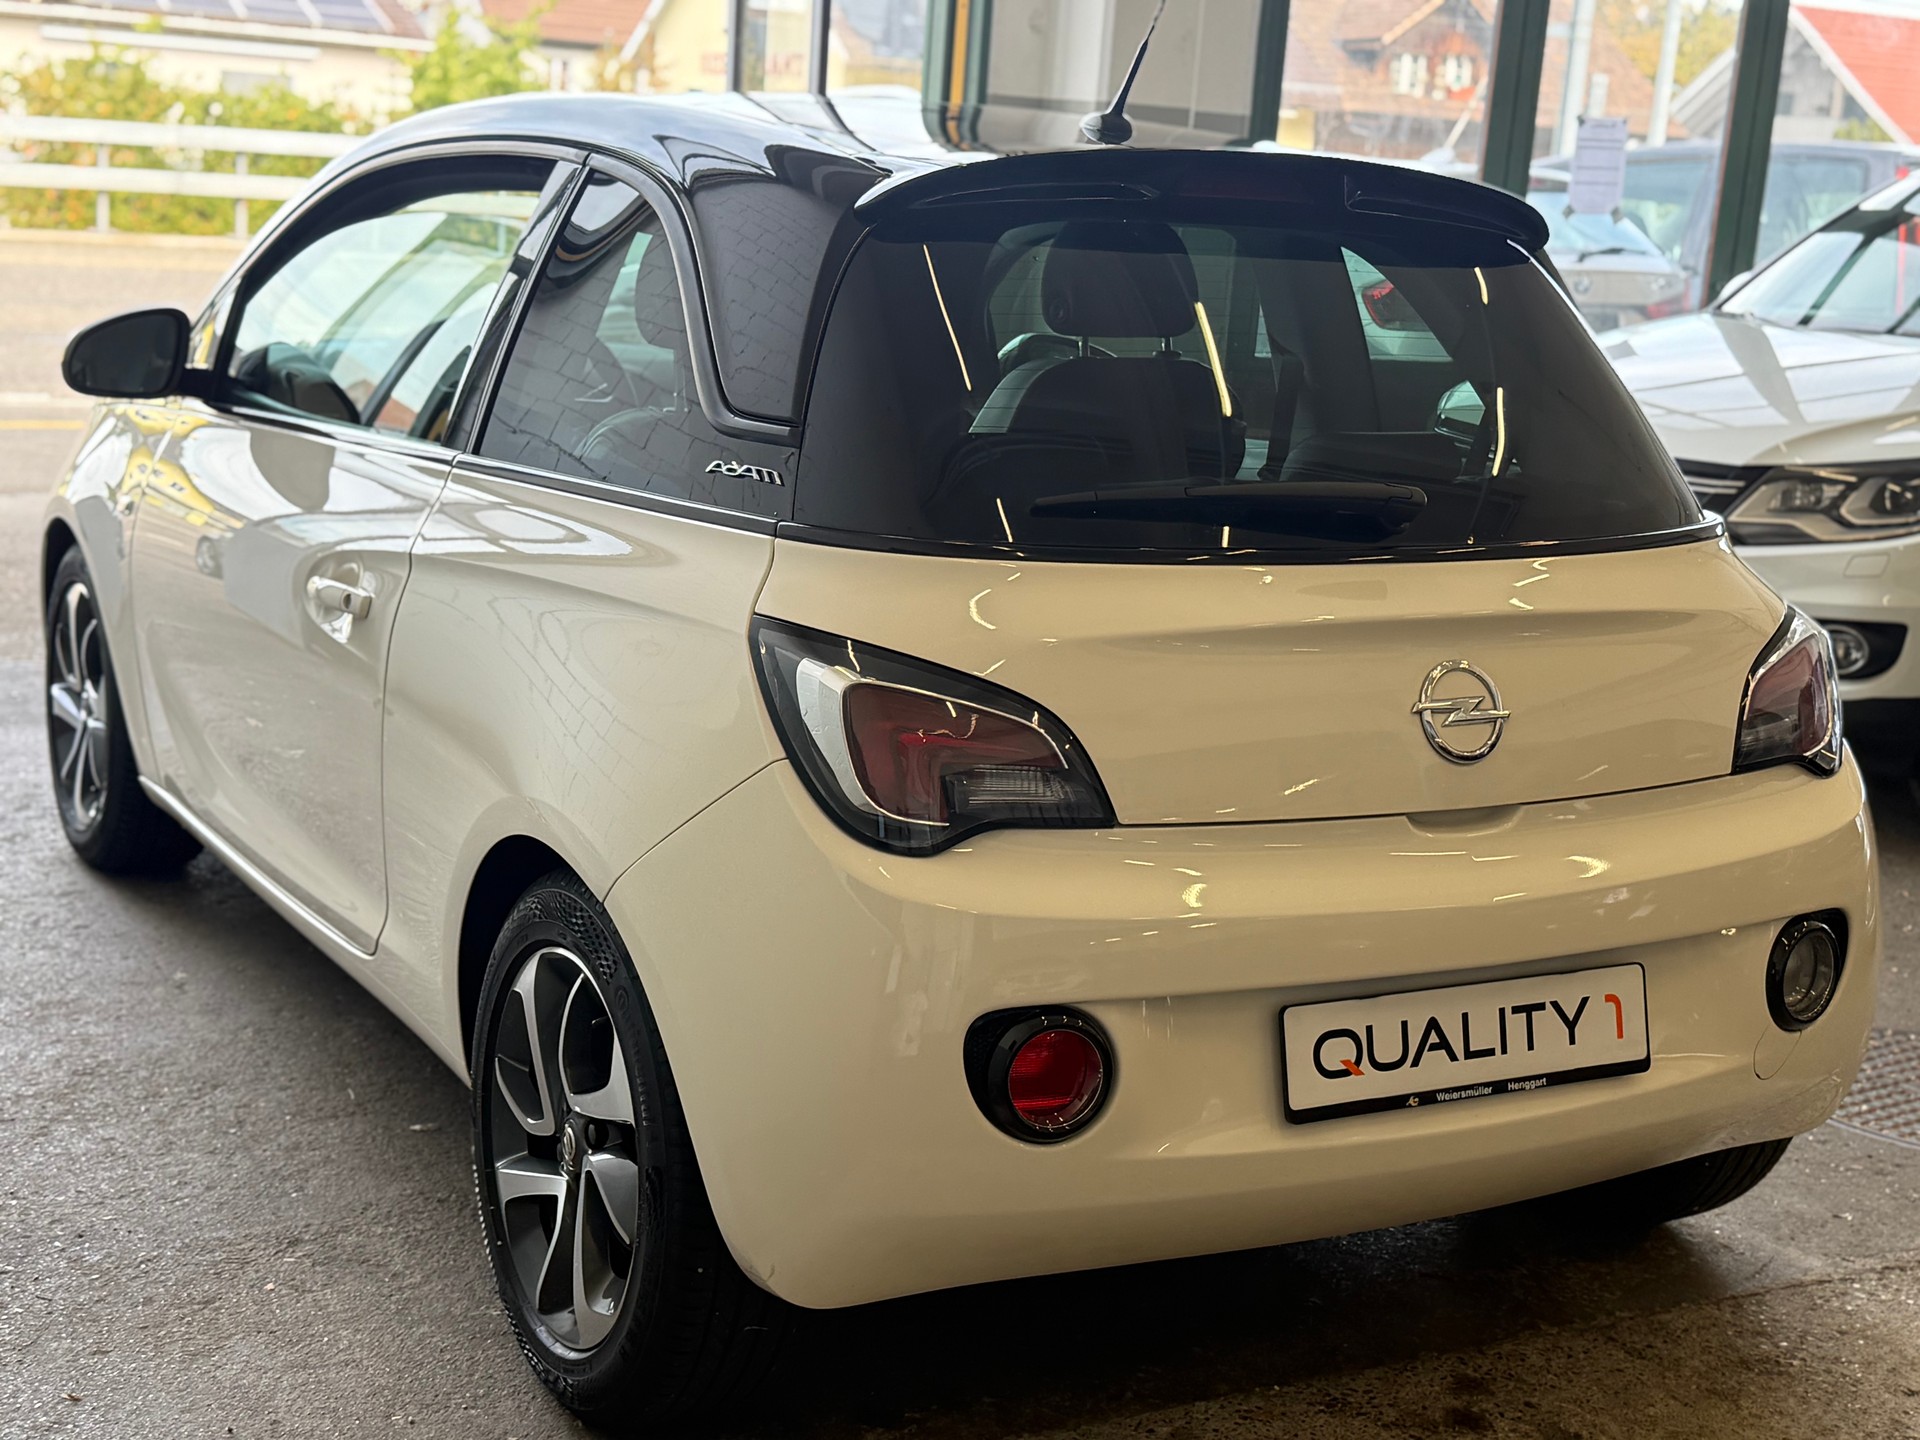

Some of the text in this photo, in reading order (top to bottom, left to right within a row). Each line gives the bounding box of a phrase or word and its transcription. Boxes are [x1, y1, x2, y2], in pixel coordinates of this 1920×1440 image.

[1313, 994, 1624, 1079] QUALITY 1
[1436, 1086, 1493, 1101] Weiersmüller
[1508, 1077, 1547, 1091] Henggart
